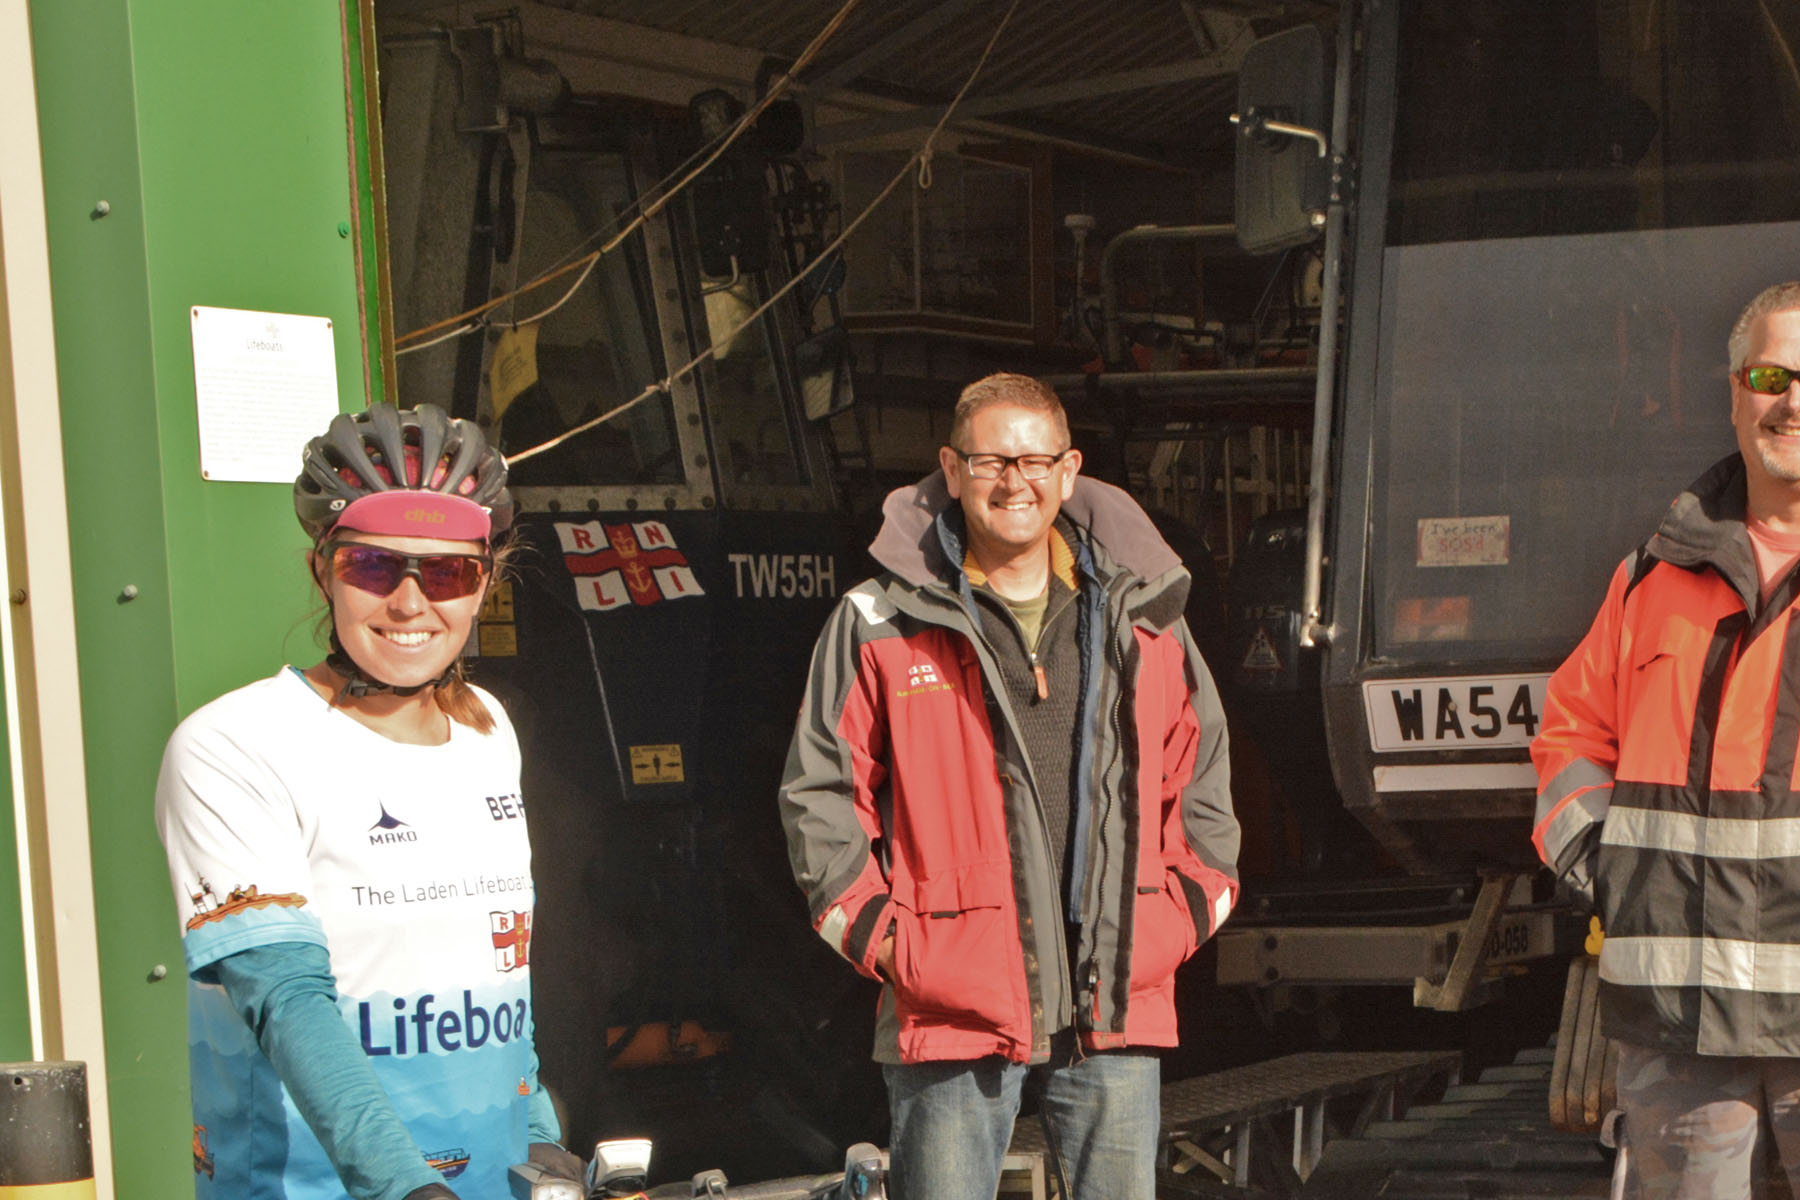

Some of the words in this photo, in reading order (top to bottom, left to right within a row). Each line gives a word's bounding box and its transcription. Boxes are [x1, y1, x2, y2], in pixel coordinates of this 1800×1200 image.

[572, 527, 595, 549] R
[643, 524, 666, 546] N
[593, 581, 616, 606] L
[670, 571, 685, 592] I
[728, 554, 836, 598] TW55H
[1391, 684, 1539, 741] WA54
[369, 831, 417, 845] MAKO
[351, 886, 396, 906] The
[402, 881, 458, 903] Laden
[464, 874, 527, 896] Lifeboat
[500, 917, 509, 930] R
[503, 952, 511, 967] L
[359, 990, 527, 1056] Lifeboa
